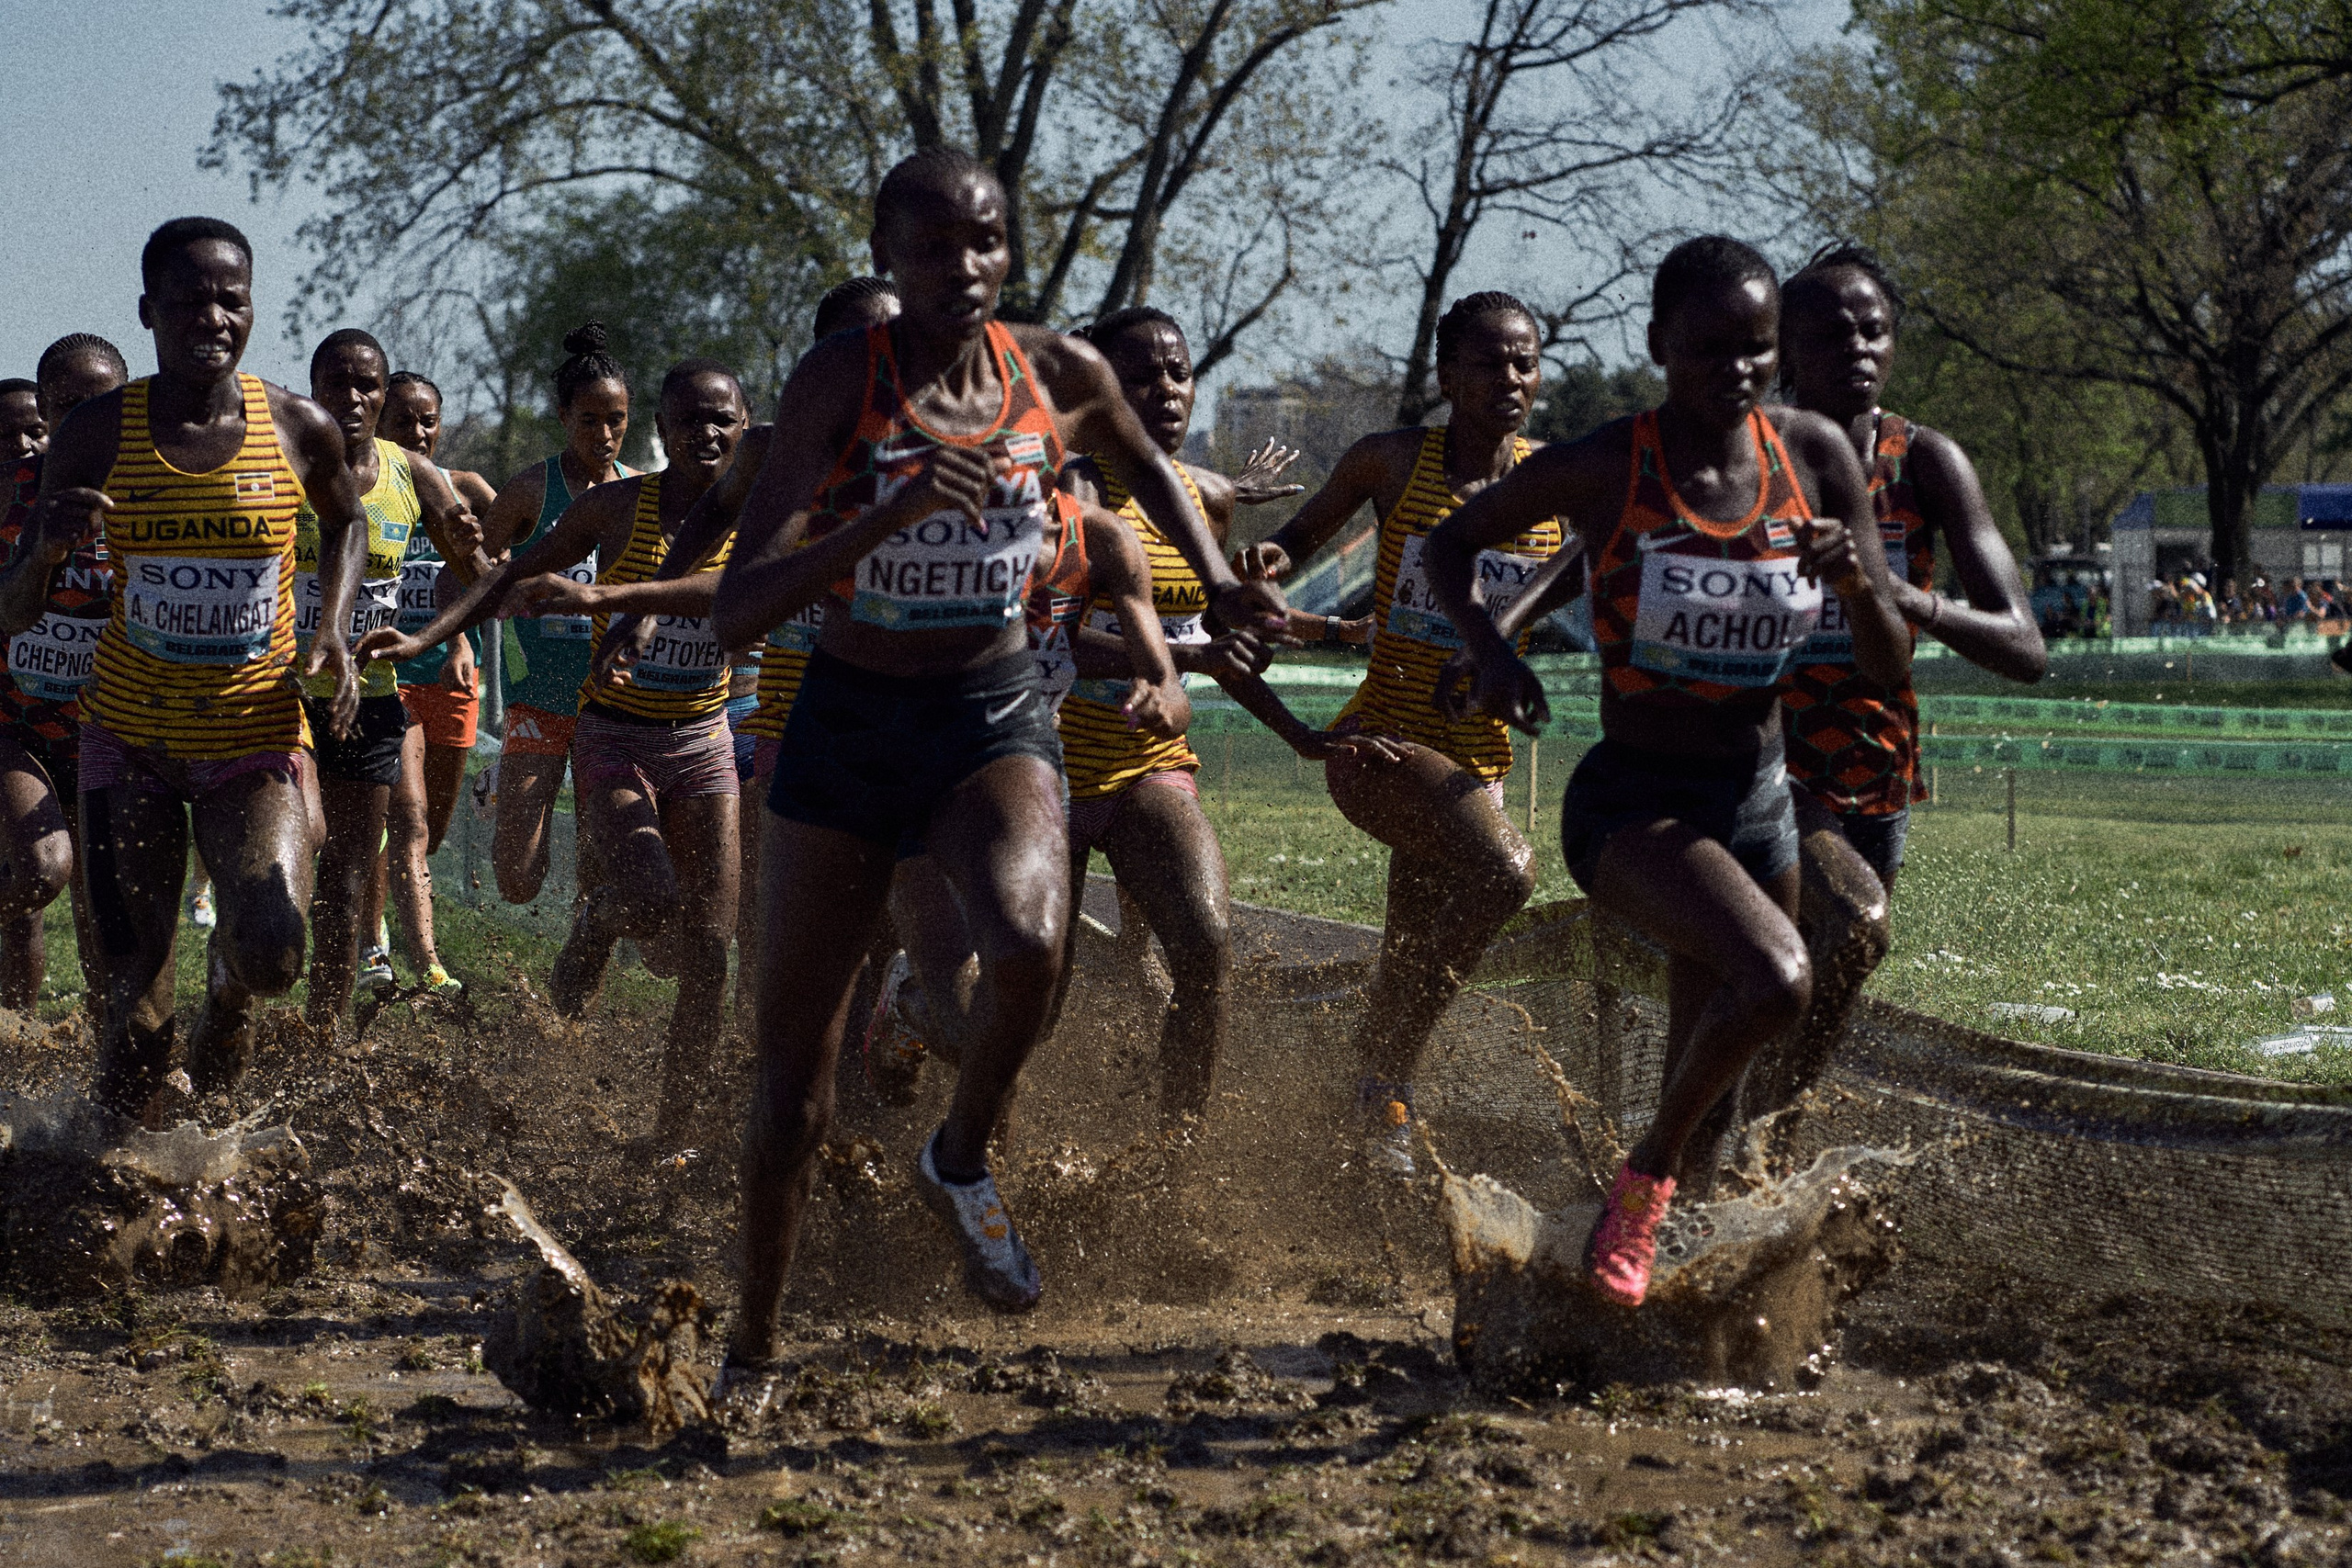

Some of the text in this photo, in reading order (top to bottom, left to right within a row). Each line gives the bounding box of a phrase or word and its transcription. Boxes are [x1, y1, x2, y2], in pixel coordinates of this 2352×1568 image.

[130, 515, 272, 542] UGANDA
[140, 563, 270, 591] SONY
[869, 554, 1031, 595] NGETICH
[1662, 565, 1803, 598] SONY
[29, 617, 106, 643] SON
[154, 596, 273, 637] CHELANGAT
